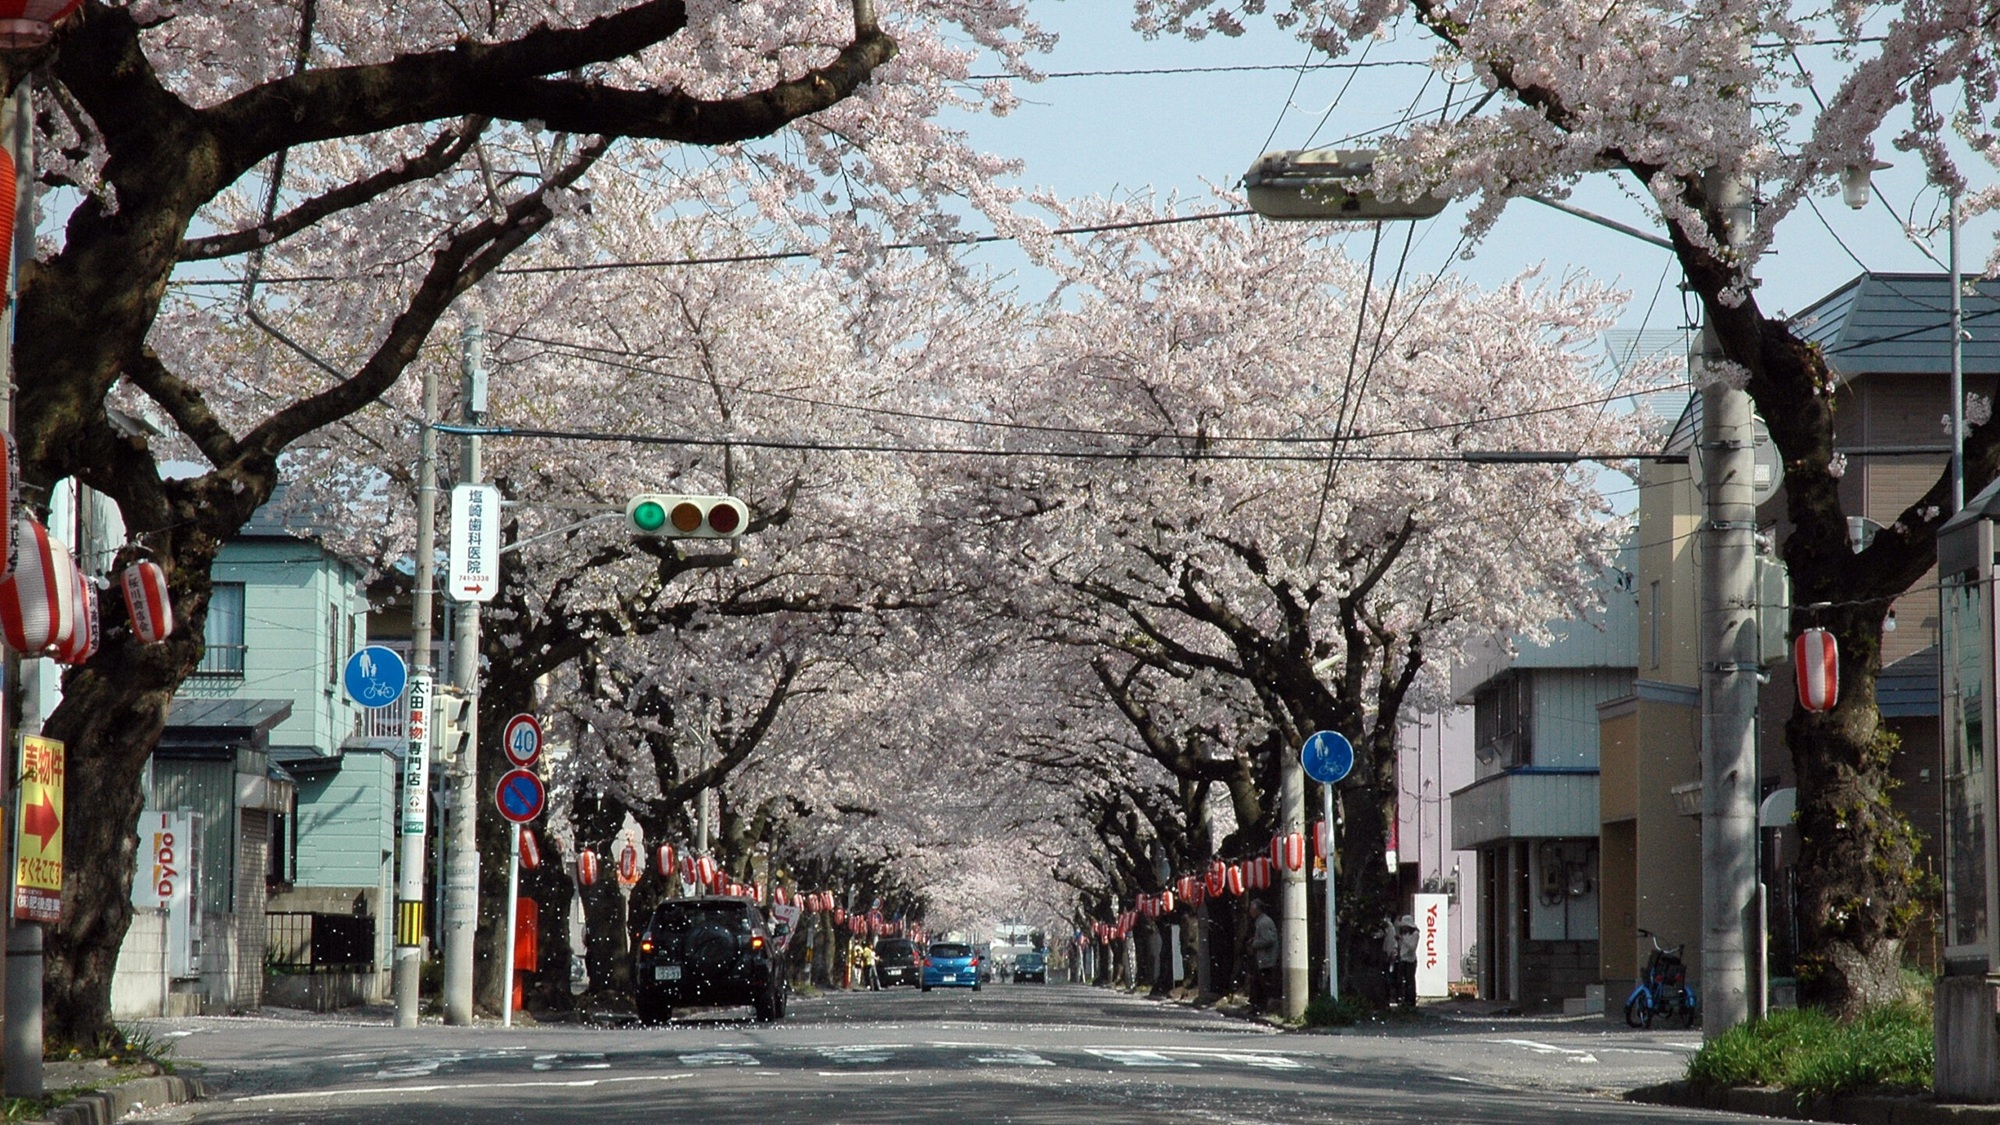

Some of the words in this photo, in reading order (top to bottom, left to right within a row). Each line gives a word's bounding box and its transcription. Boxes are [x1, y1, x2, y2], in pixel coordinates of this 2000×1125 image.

[467, 489, 483, 574] 塩崎歯科医院
[407, 679, 425, 786] 太田果物専門店
[513, 729, 535, 753] 40
[25, 744, 63, 787] 売物件
[20, 855, 61, 884] すぐそこです
[158, 832, 178, 897] DyDo
[1426, 903, 1438, 969] Yakult
